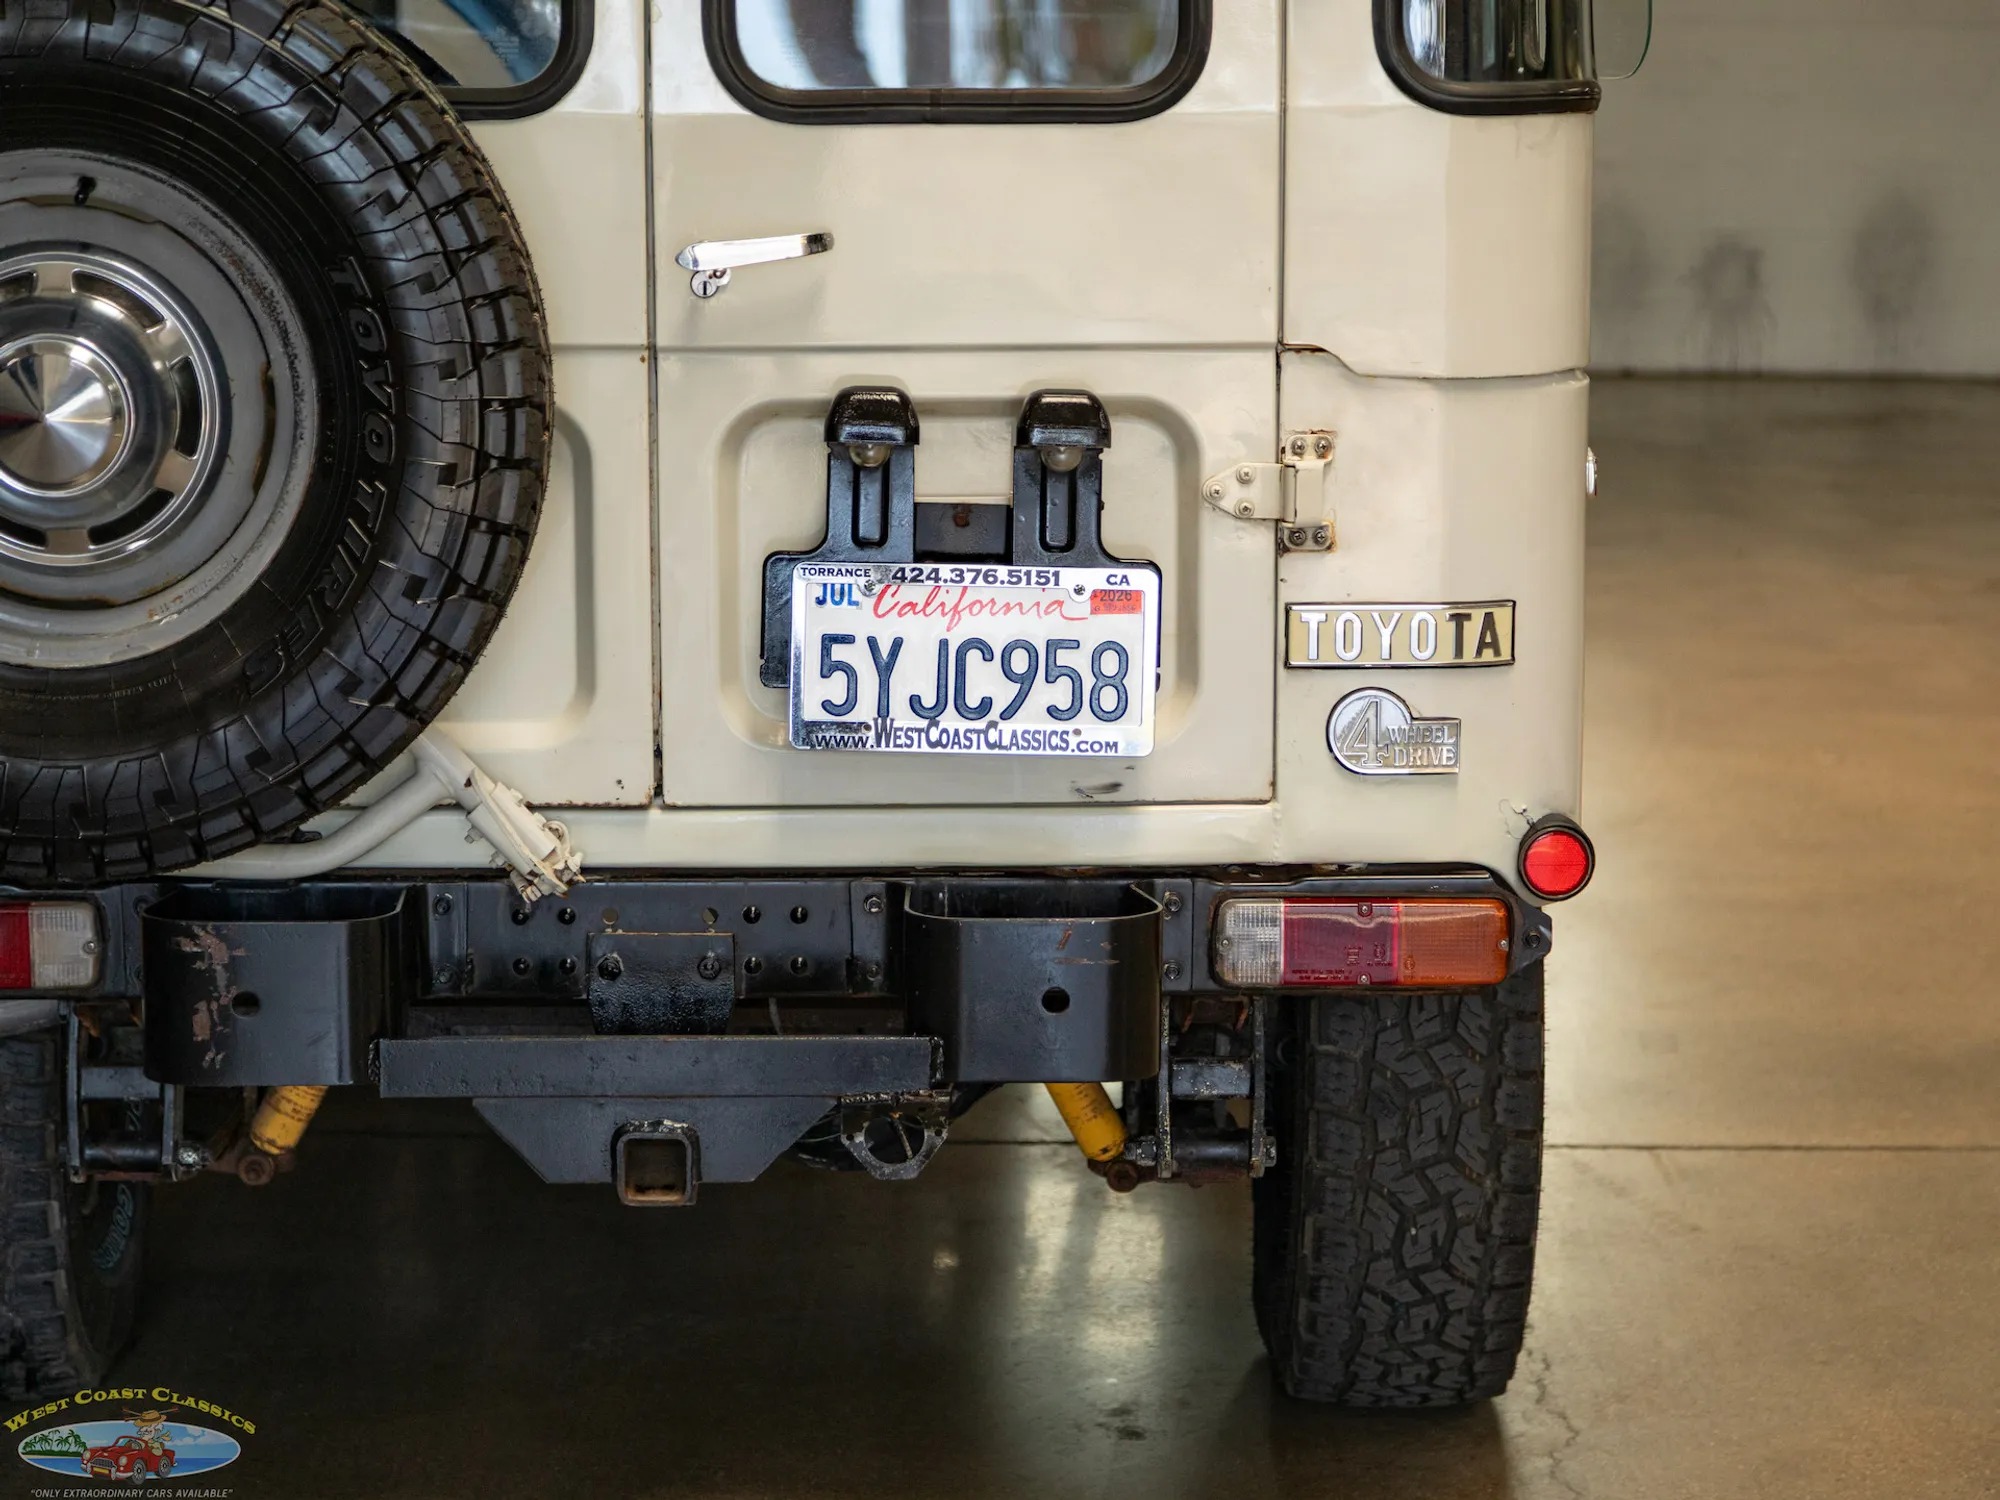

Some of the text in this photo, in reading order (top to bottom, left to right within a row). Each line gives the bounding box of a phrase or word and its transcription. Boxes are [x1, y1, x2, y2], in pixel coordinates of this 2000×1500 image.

[242, 255, 397, 699] TOYO TIRES
[801, 566, 1131, 587] TORRANCE 424.376.5151 CA
[815, 583, 860, 606] JUL
[872, 584, 1089, 632] California
[1300, 611, 1502, 661] TOYOTA
[820, 633, 1130, 722] 5YJC958
[1343, 697, 1456, 767] 4 WHEEL
[1392, 745, 1456, 768] DRIVE
